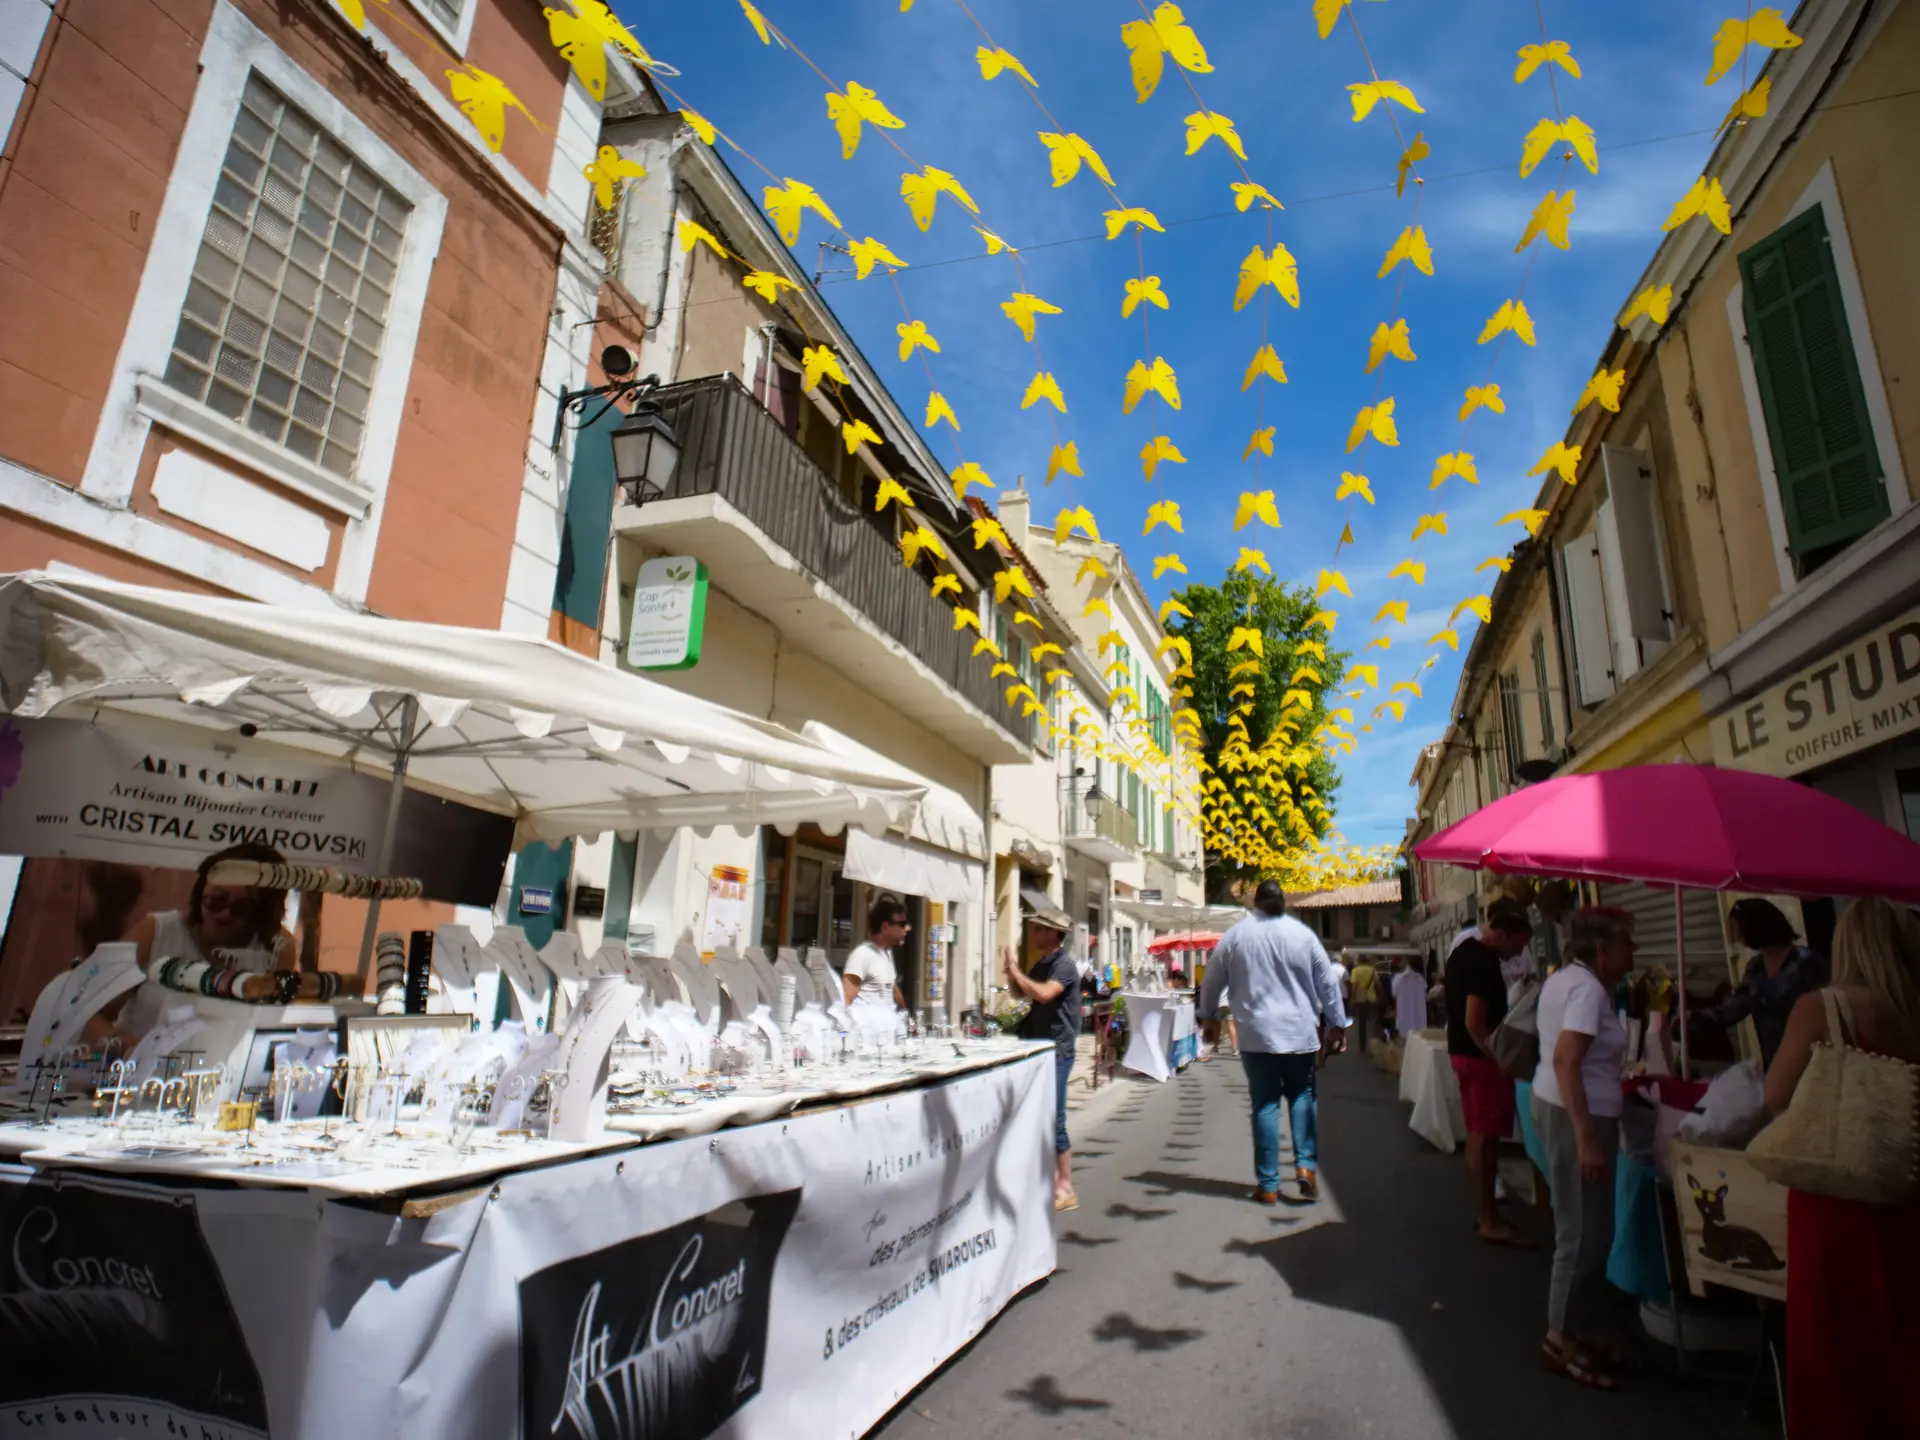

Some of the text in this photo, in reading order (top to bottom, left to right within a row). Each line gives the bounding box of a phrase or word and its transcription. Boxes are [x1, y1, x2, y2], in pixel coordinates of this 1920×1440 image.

[637, 601, 668, 614] Santé
[638, 591, 659, 602] Cap
[1727, 701, 1770, 760] LE
[1785, 719, 1866, 766] COIFFURE
[131, 753, 323, 798] ART CONCRET
[109, 781, 326, 824] Artisan Bijoutier Créateur
[35, 803, 367, 860] WITH CRISTAL SWAROVSKI
[864, 1150, 921, 1186] Artisan
[13, 1205, 163, 1300] Concret
[823, 1228, 997, 1360] & des cristaux de SWAROVSKI
[551, 1233, 746, 1434] Art Concret
[16, 1402, 150, 1427] Créateur
[167, 1412, 188, 1439] de
